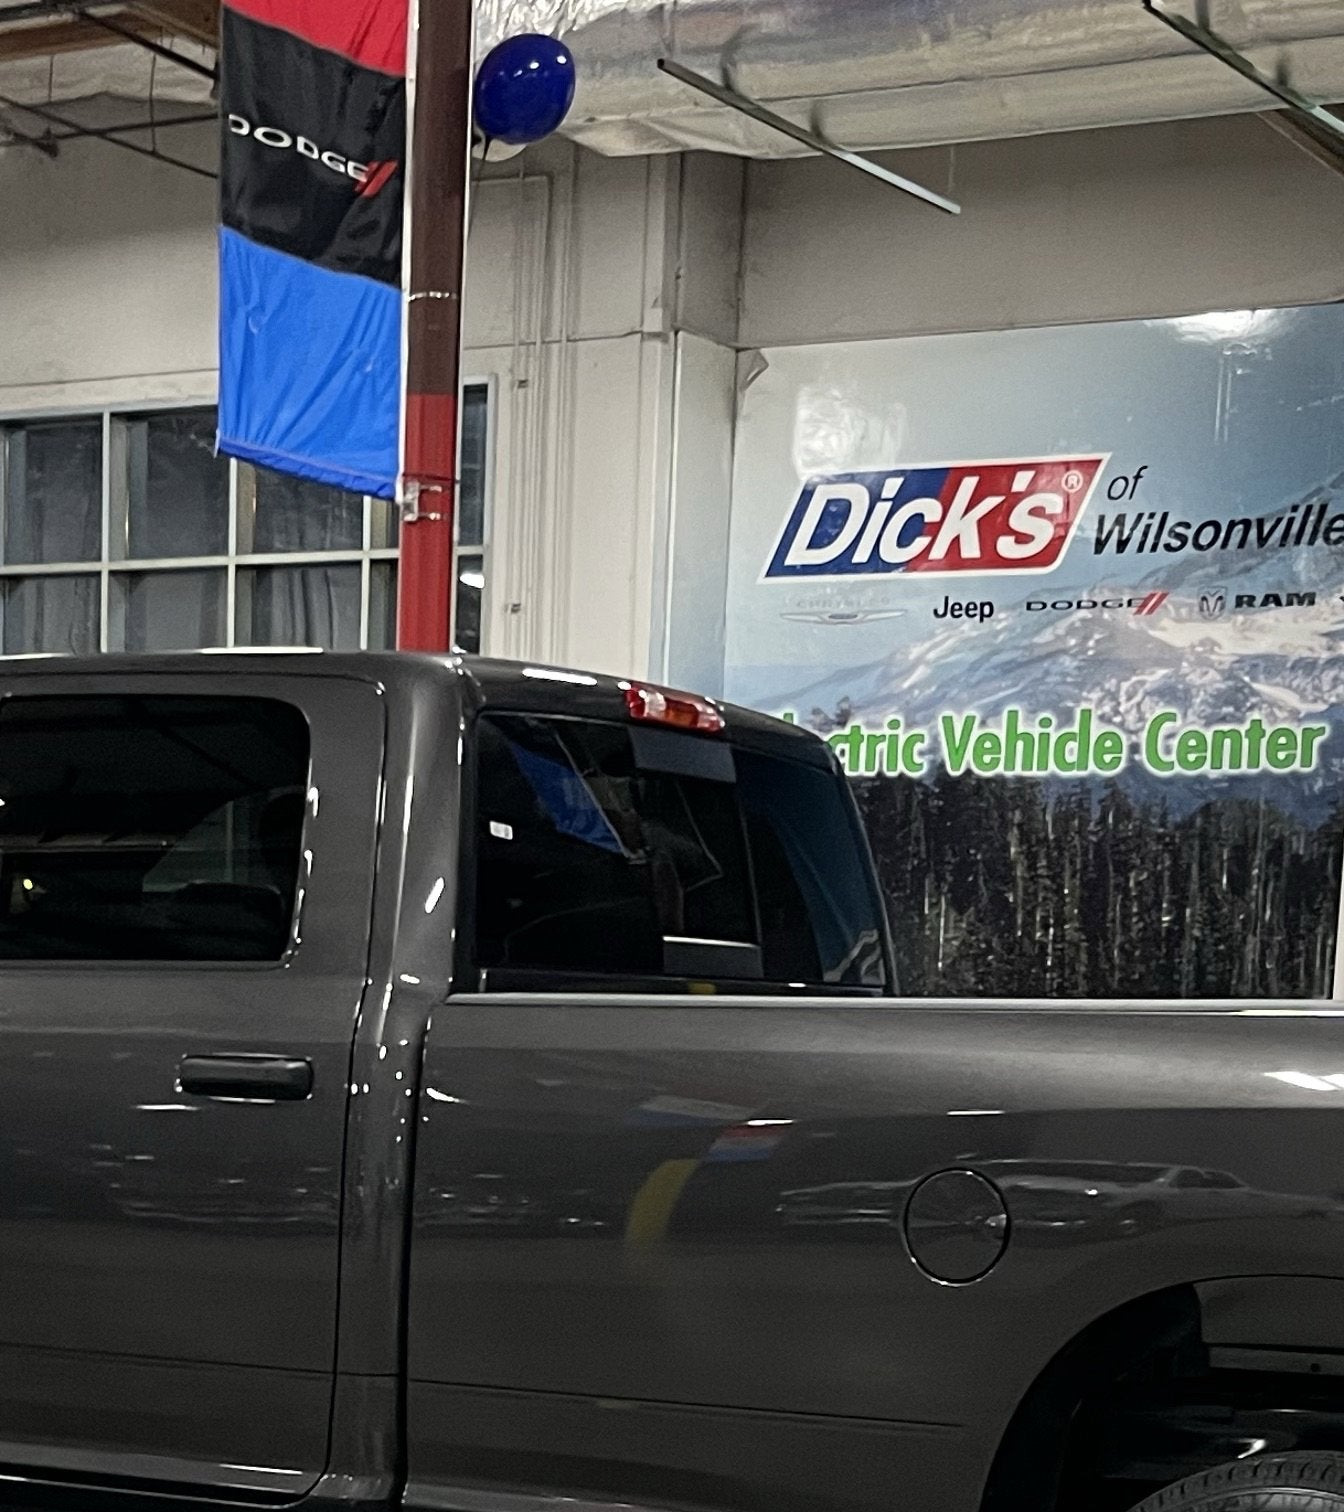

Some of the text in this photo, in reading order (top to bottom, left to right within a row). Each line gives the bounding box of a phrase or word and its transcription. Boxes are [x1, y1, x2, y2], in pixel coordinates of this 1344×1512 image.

[228, 113, 370, 183] DODGE
[1107, 465, 1148, 501] of
[933, 591, 1317, 623] Jeep DODGE RAM
[941, 709, 1124, 773] Vehicle
[1145, 712, 1325, 774] Center
